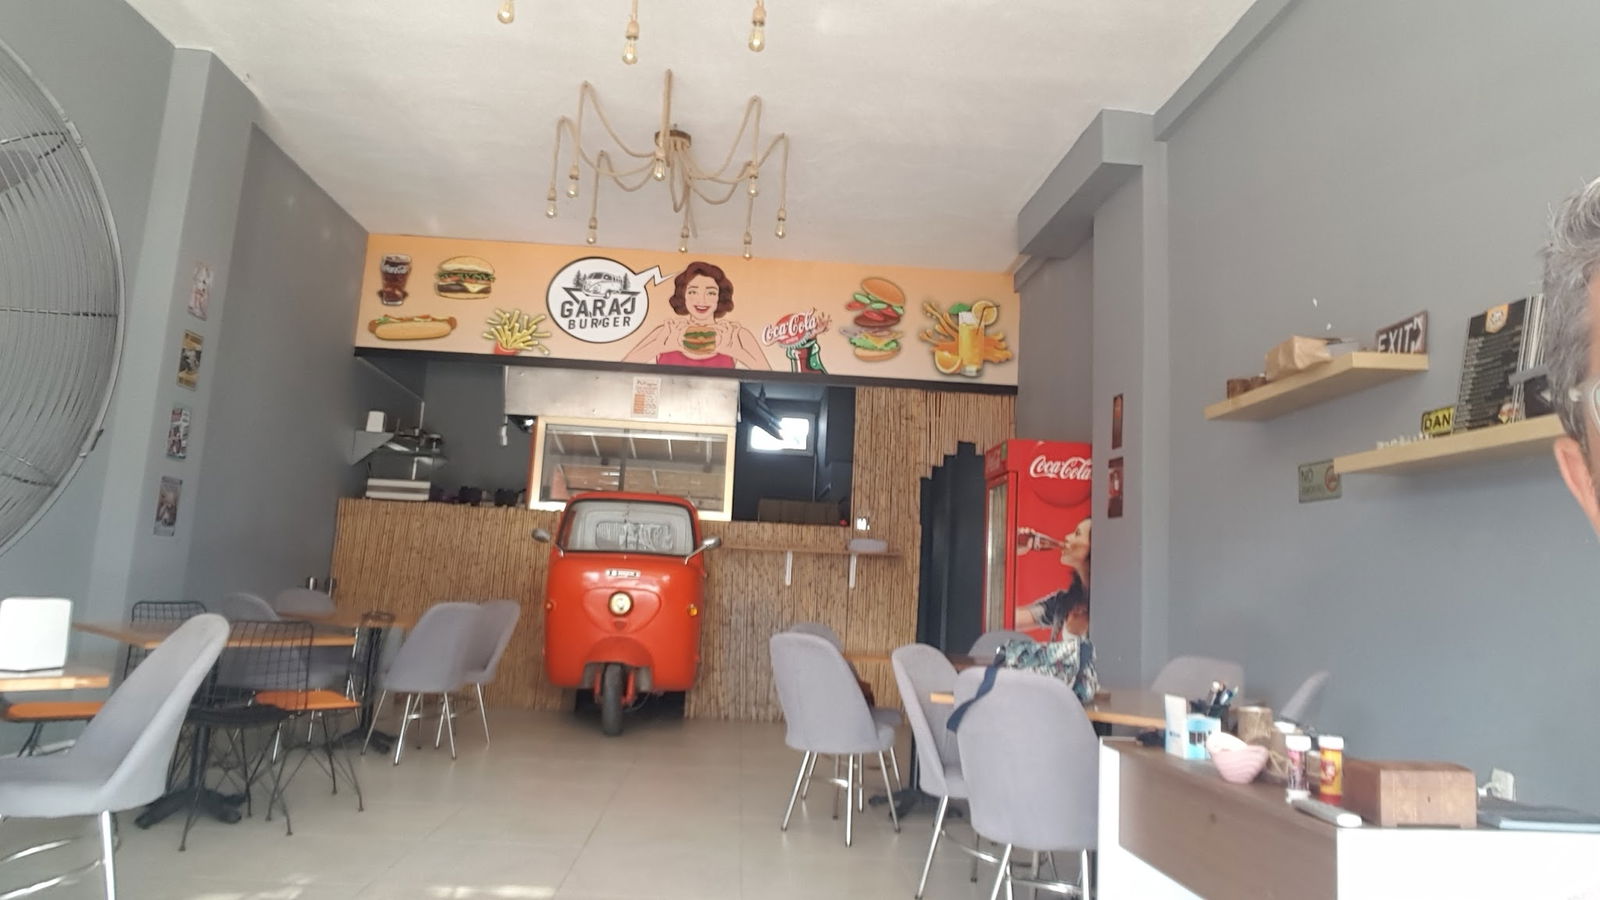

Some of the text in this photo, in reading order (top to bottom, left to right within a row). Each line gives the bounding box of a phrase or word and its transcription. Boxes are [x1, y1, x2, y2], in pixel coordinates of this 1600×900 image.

[560, 297, 636, 319] GARAJ
[568, 316, 631, 330] BURGER
[1378, 322, 1413, 353] EXIT
